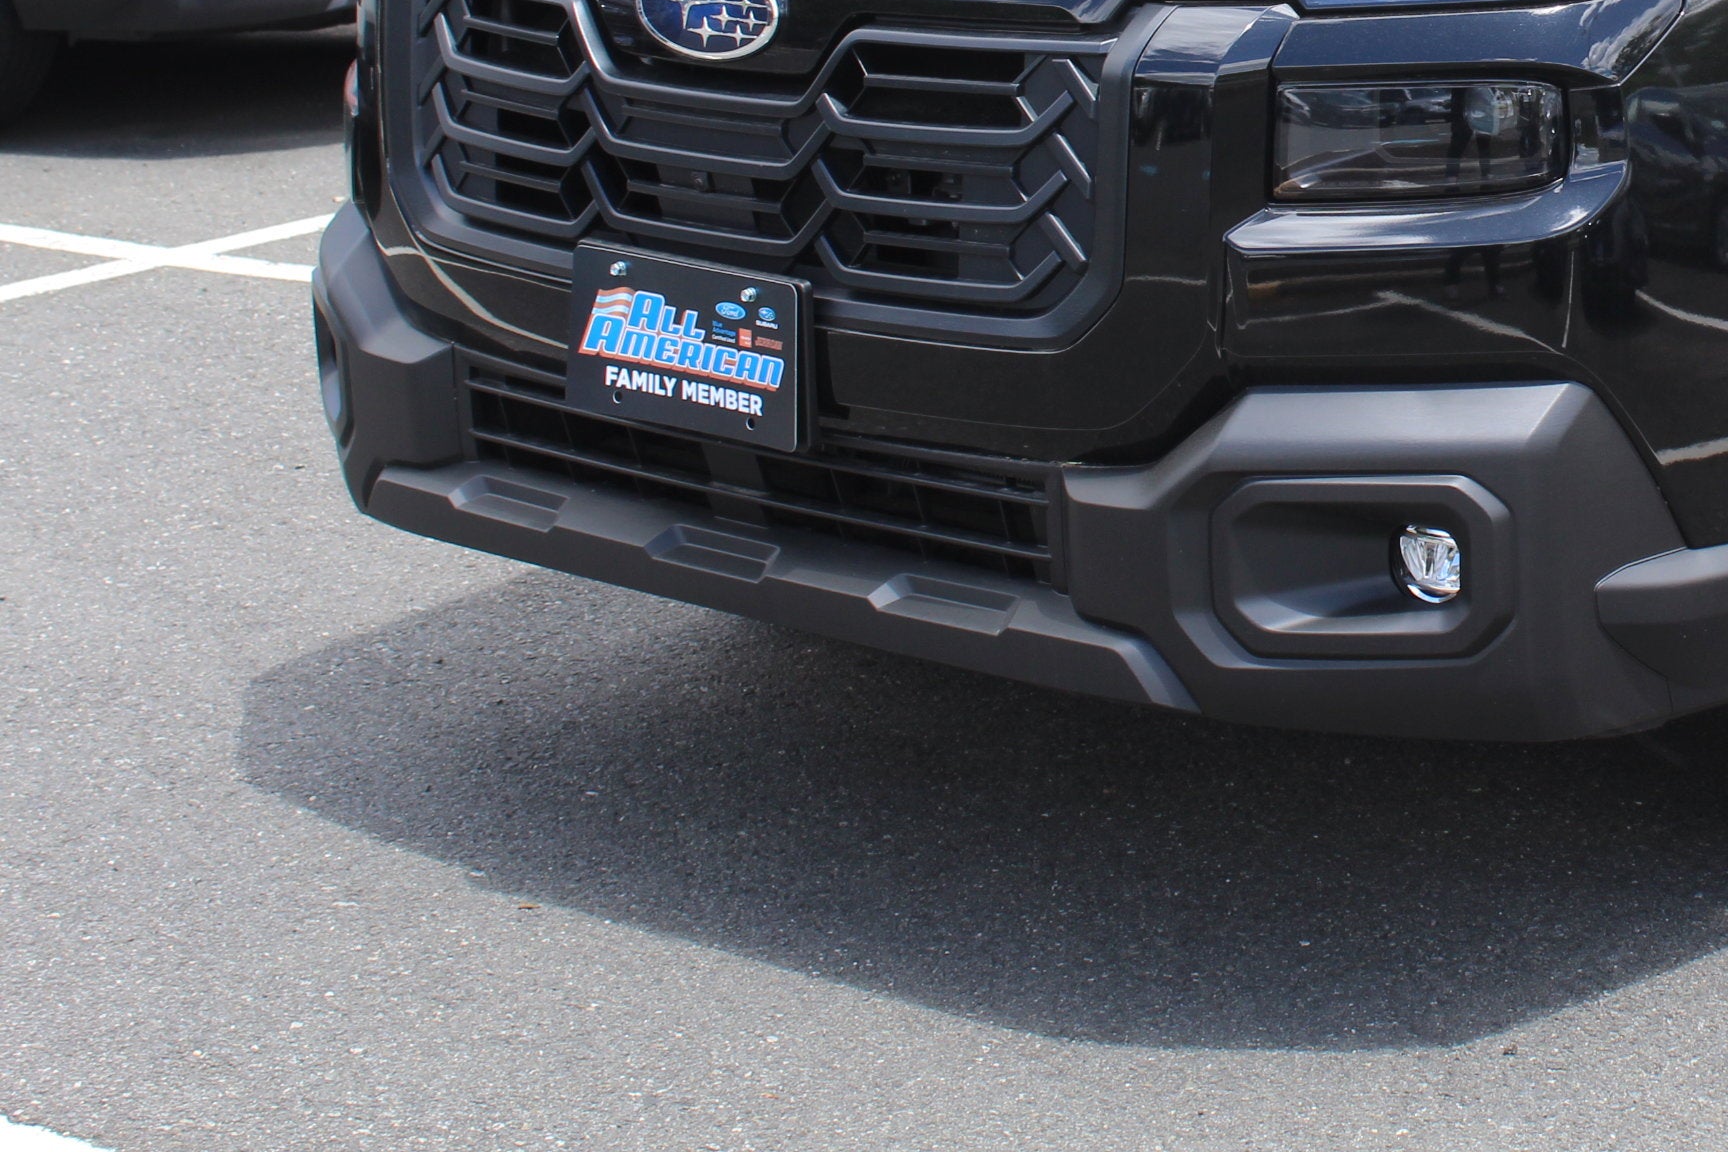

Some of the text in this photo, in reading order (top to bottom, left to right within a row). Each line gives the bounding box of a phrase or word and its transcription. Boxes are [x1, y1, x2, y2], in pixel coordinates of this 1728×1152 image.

[626, 290, 706, 342] ALL
[755, 319, 779, 330] SUBARU
[579, 313, 785, 390] AMERICAN
[605, 365, 763, 416] FAMILY MEMBER
